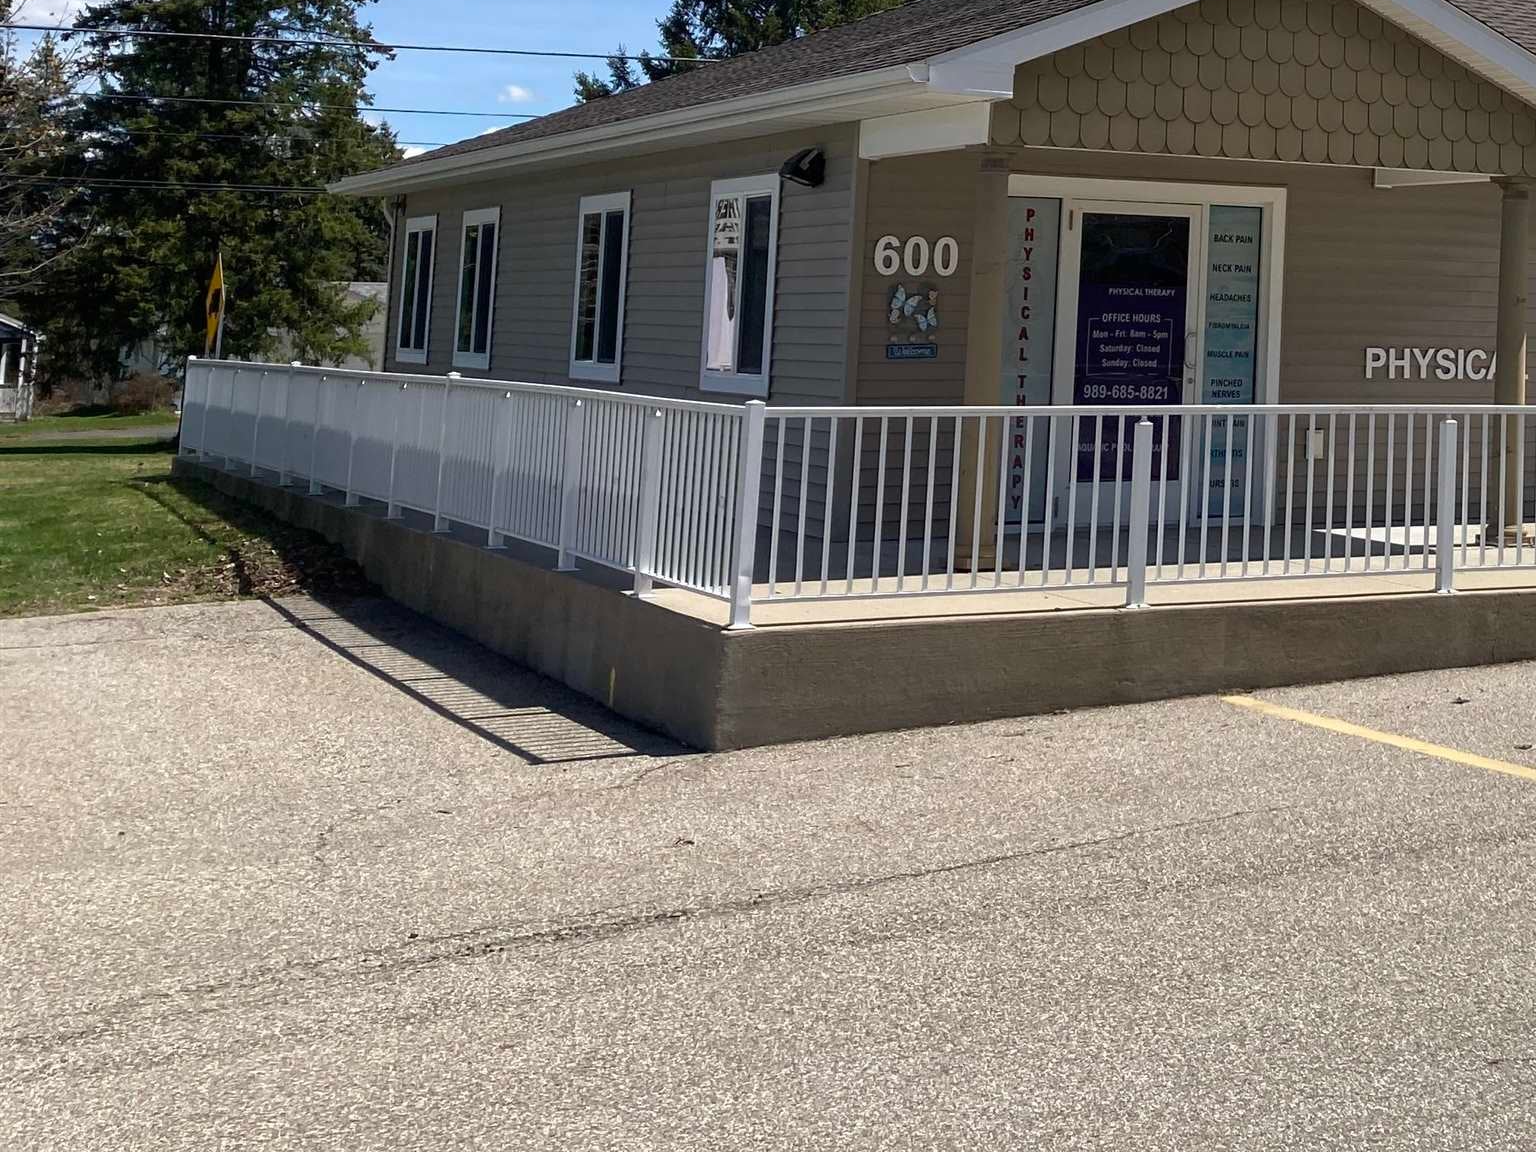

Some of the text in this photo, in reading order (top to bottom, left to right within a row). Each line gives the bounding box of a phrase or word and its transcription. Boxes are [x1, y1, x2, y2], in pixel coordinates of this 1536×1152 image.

[1214, 234, 1253, 244] BACK PAIN
[874, 234, 960, 277] 600
[1213, 264, 1252, 273] NECK PAIN
[1109, 288, 1176, 298] PHYSICAL THERAPY
[1209, 293, 1252, 303] HEADACHES
[1102, 313, 1161, 323] OFFICE HOURS
[1136, 344, 1161, 353] Closed
[1012, 209, 1035, 510] PHYSICAL THERAPY
[1207, 350, 1249, 359] MUSCLE PAIN
[1132, 358, 1158, 368] Closed
[1365, 347, 1529, 380] PHYSIC
[1210, 378, 1243, 388] PINCHED
[1083, 384, 1169, 400] 989-685-8821
[1211, 389, 1241, 399] NERVES
